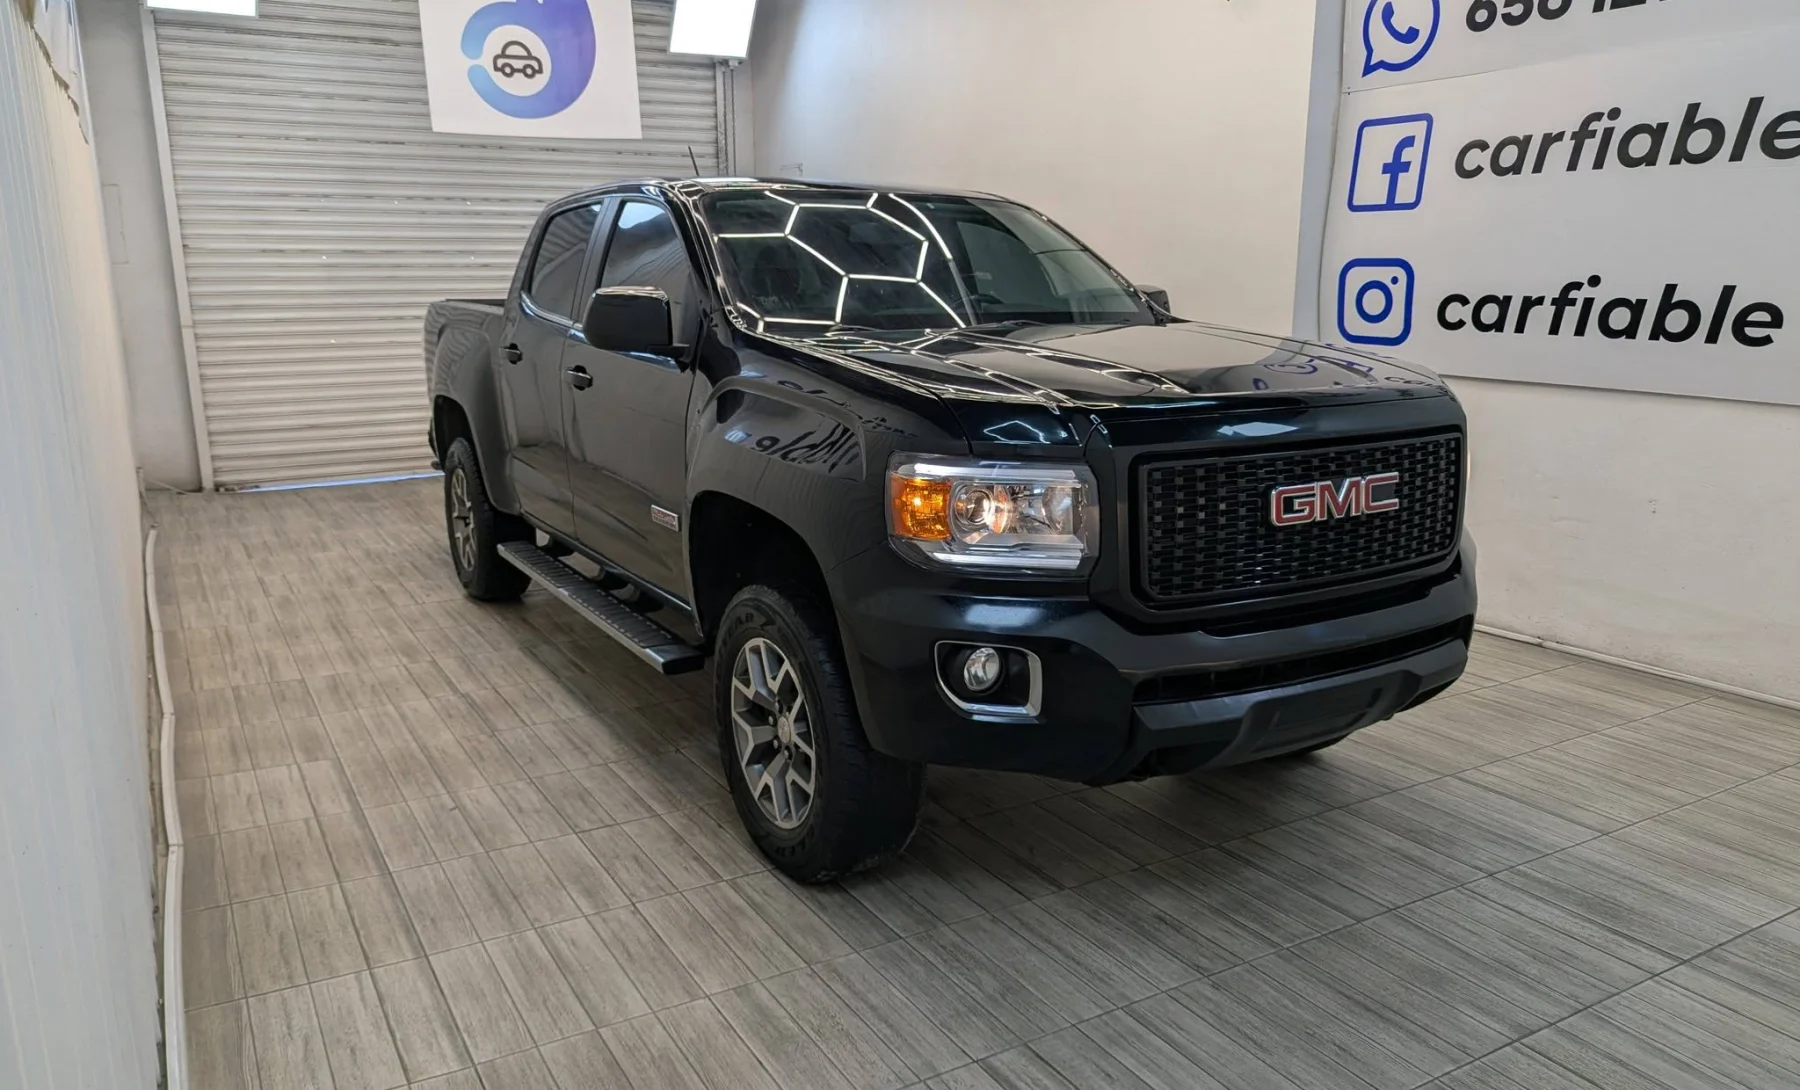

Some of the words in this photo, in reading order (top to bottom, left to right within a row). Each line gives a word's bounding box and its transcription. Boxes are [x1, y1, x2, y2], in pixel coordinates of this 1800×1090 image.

[1455, 96, 1800, 179] carfiable
[1437, 275, 1783, 347] carfiable
[1271, 472, 1399, 527] GMC
